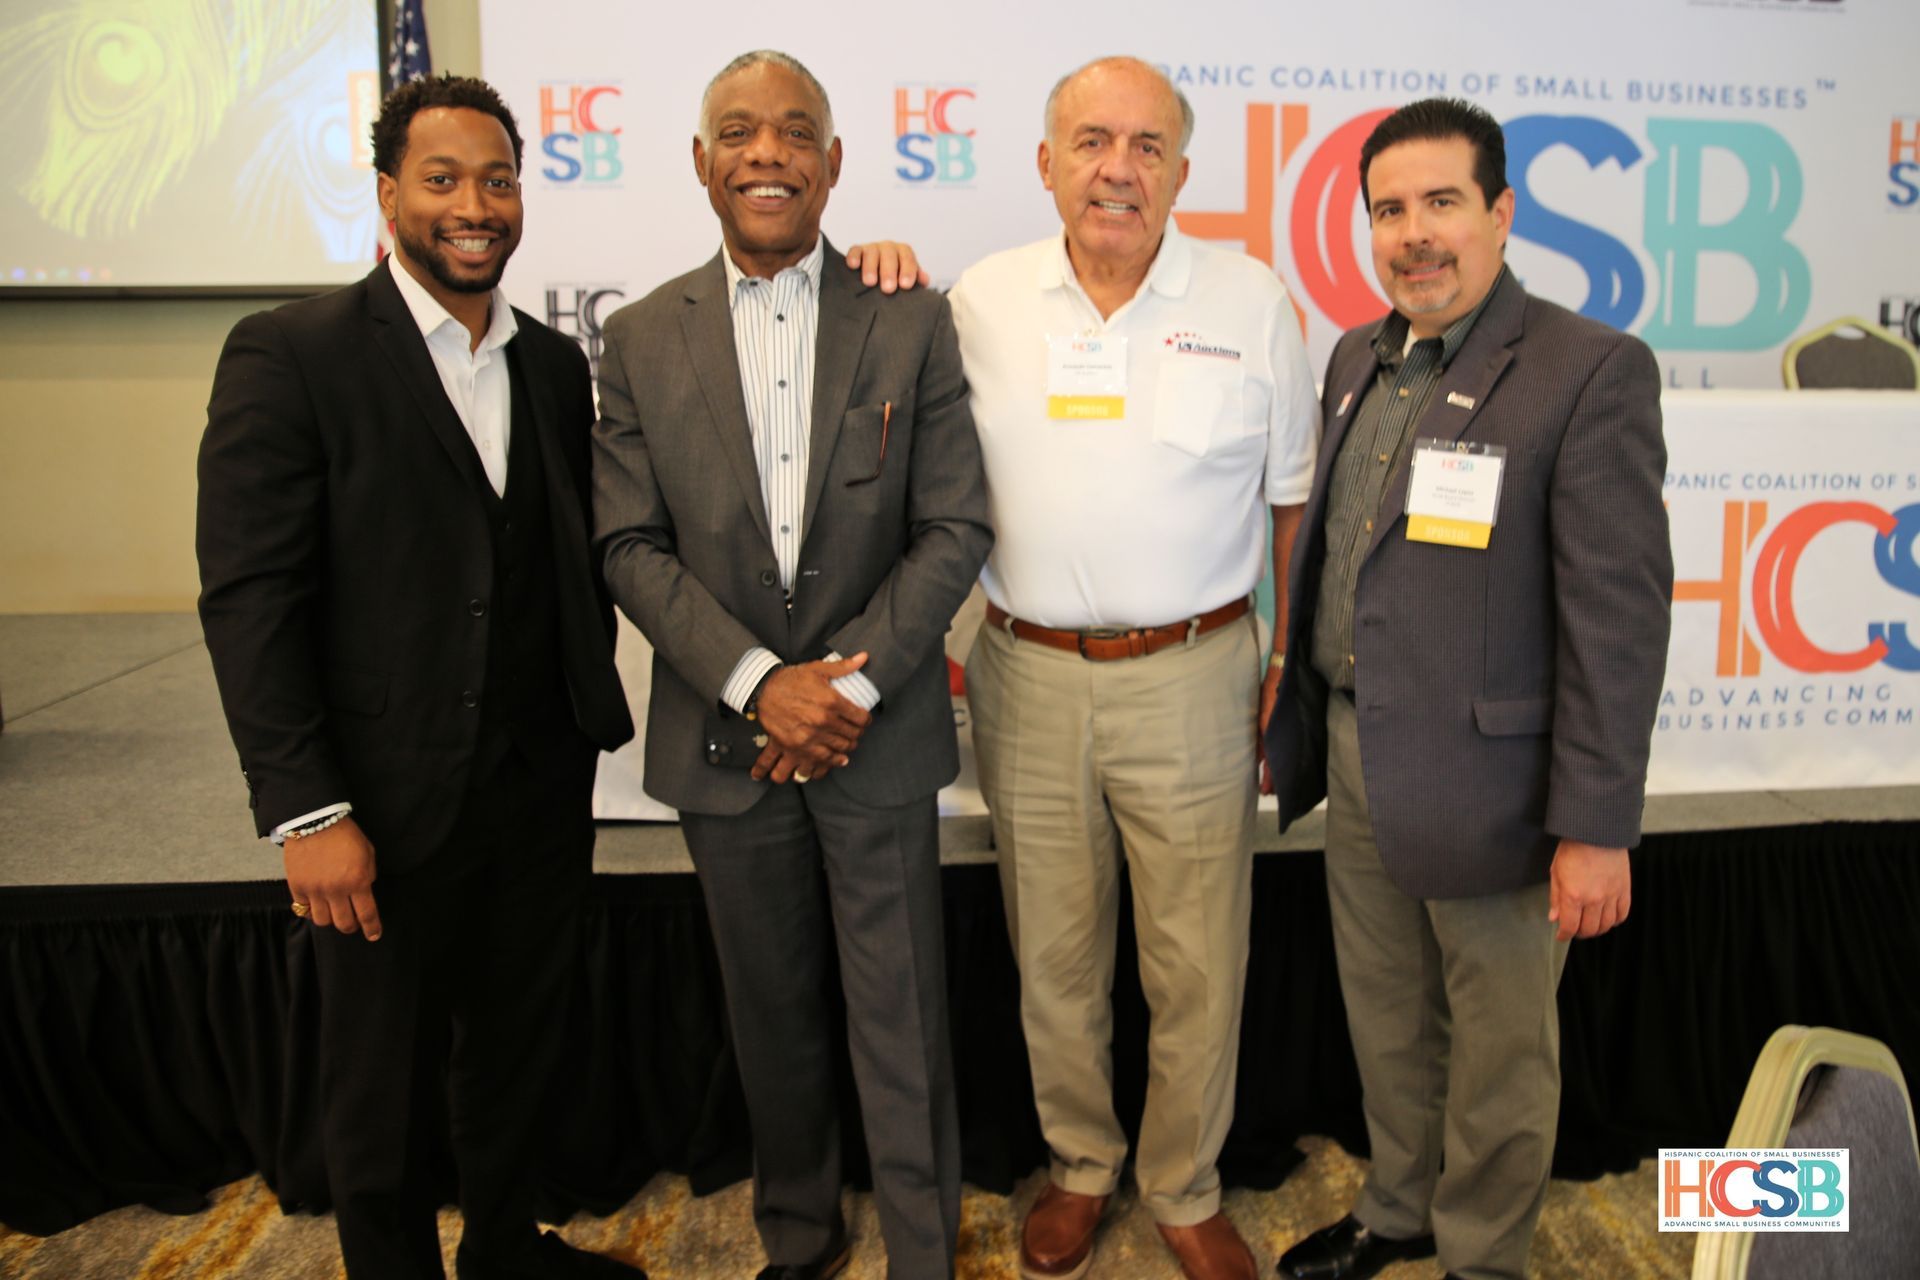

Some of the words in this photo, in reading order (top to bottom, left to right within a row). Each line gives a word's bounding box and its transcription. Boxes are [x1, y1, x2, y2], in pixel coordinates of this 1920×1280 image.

[1270, 65, 1446, 93] COALITION
[1461, 72, 1500, 95] OF
[1515, 75, 1614, 101] SMALL
[1627, 79, 1808, 109] BUSINESSES
[1742, 473, 1861, 491] COALITION
[1871, 474, 1897, 490] OF
[1661, 683, 1891, 706] ADVANCING
[1658, 710, 1805, 731] BUSINESS
